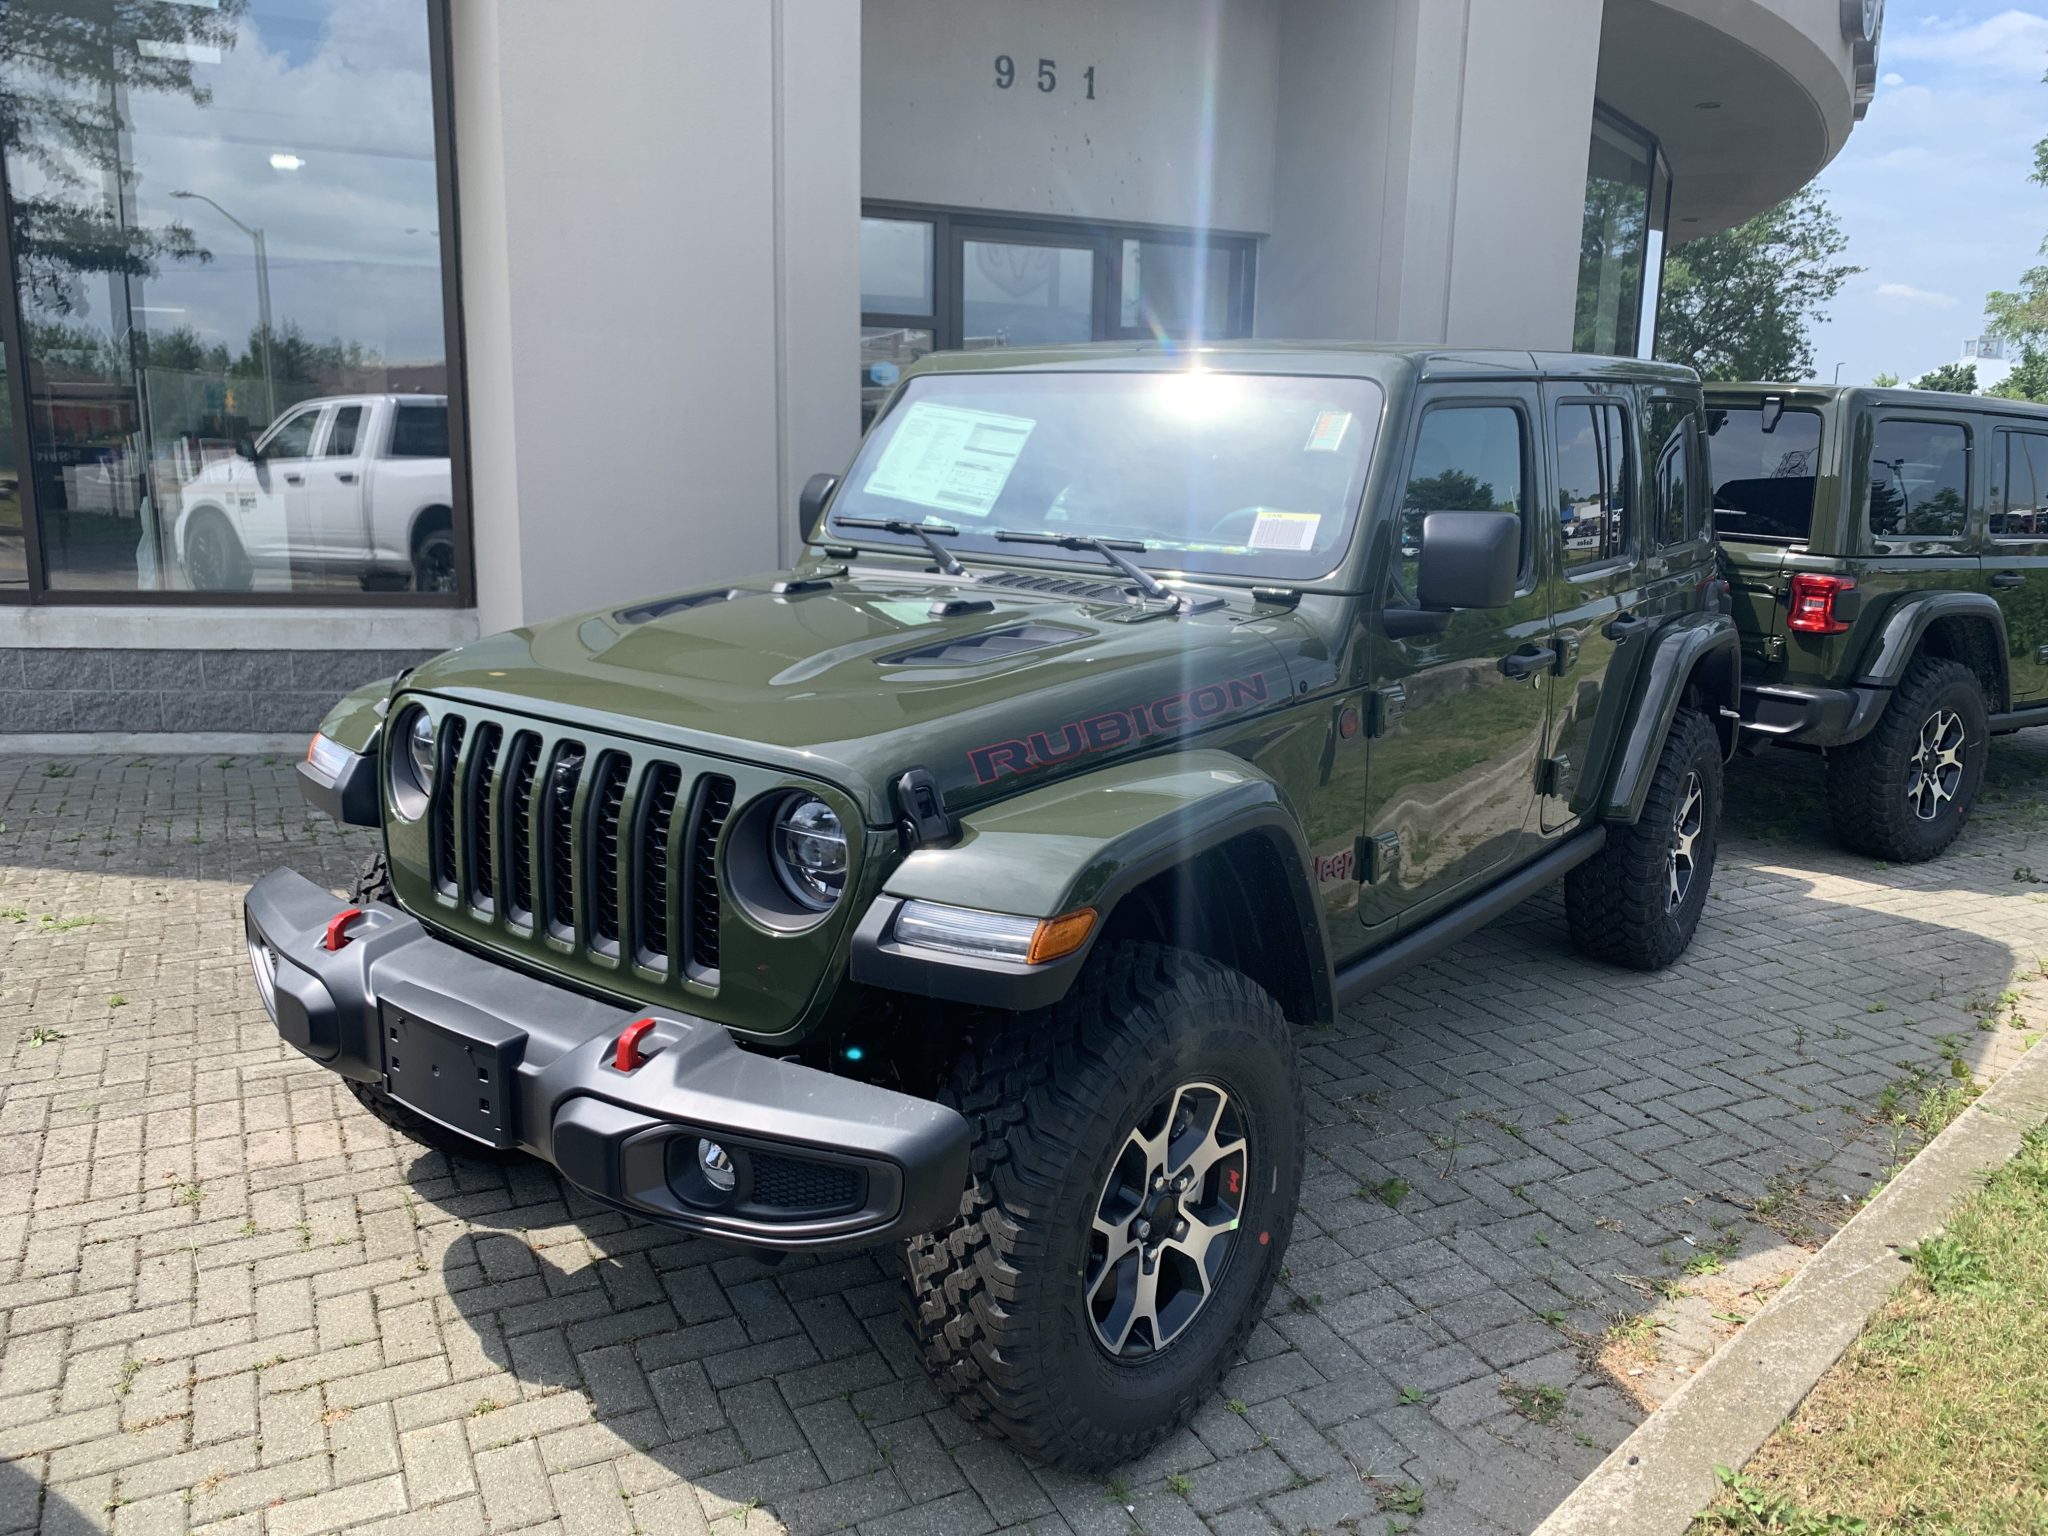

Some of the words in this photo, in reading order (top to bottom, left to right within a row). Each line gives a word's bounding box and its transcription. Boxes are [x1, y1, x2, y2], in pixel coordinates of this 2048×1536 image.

[994, 54, 1096, 100] 951
[967, 672, 1269, 784] RUBICON
[1315, 851, 1356, 882] Jeep
